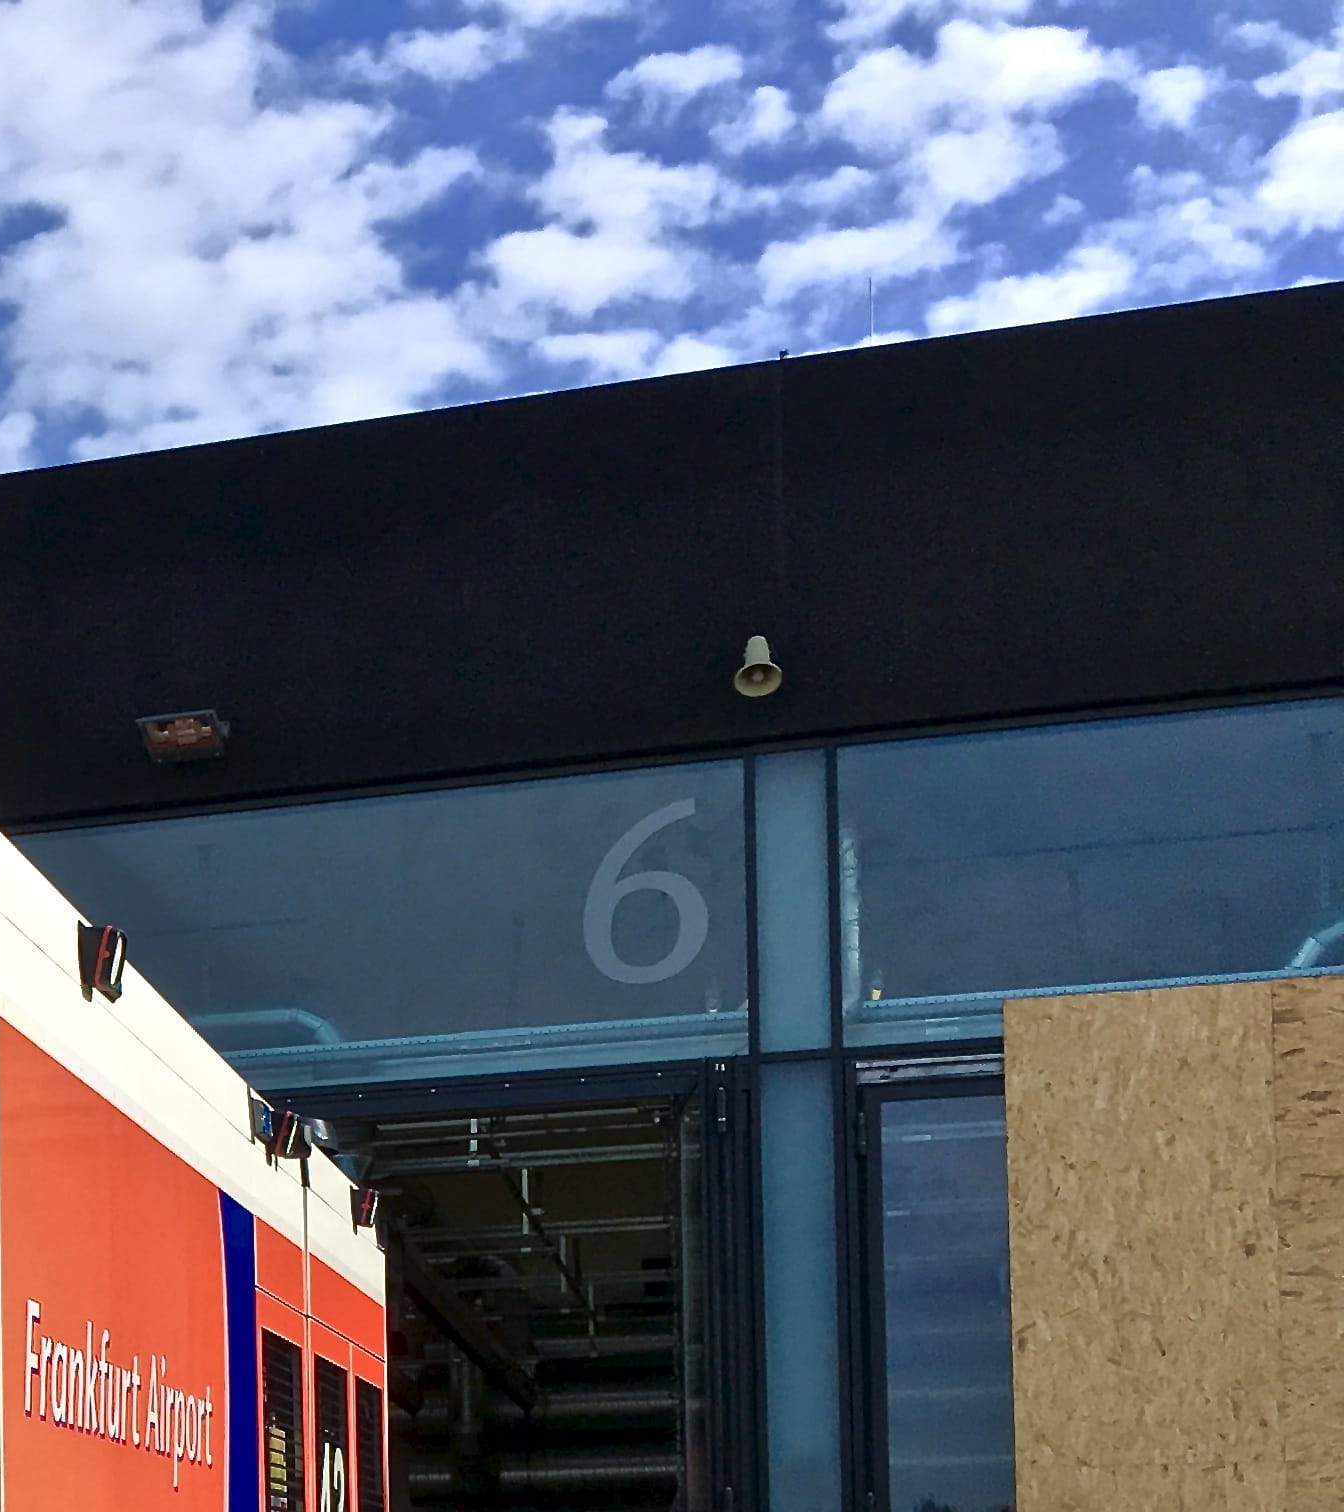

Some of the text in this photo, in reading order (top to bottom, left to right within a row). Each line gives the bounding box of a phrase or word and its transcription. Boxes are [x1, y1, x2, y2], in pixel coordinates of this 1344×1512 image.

[583, 798, 709, 984] 6
[24, 1298, 214, 1493] Frankfurt Airport
